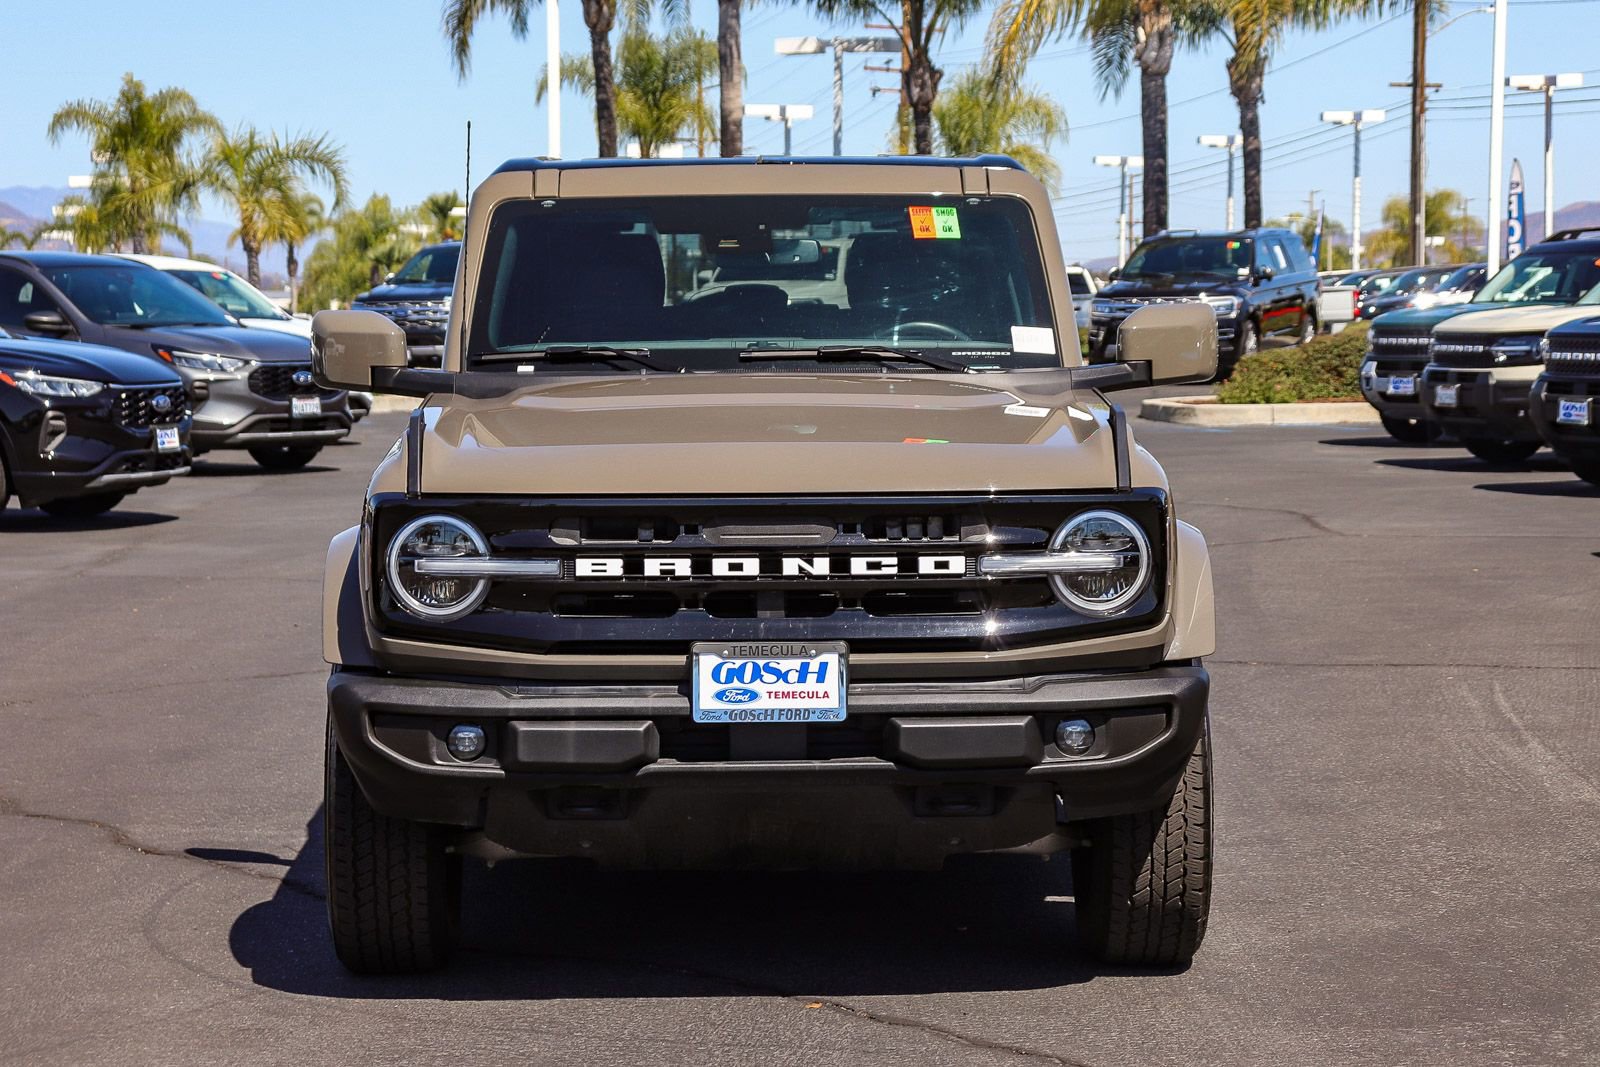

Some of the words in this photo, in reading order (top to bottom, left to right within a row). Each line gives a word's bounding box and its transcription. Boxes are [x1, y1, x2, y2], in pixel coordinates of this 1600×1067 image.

[575, 557, 966, 576] BRONCO
[730, 645, 809, 657] TEMECULA
[722, 689, 751, 702] Ford
[766, 690, 830, 700] TEMECULA
[700, 710, 723, 721] Ford
[778, 708, 811, 721] FORD
